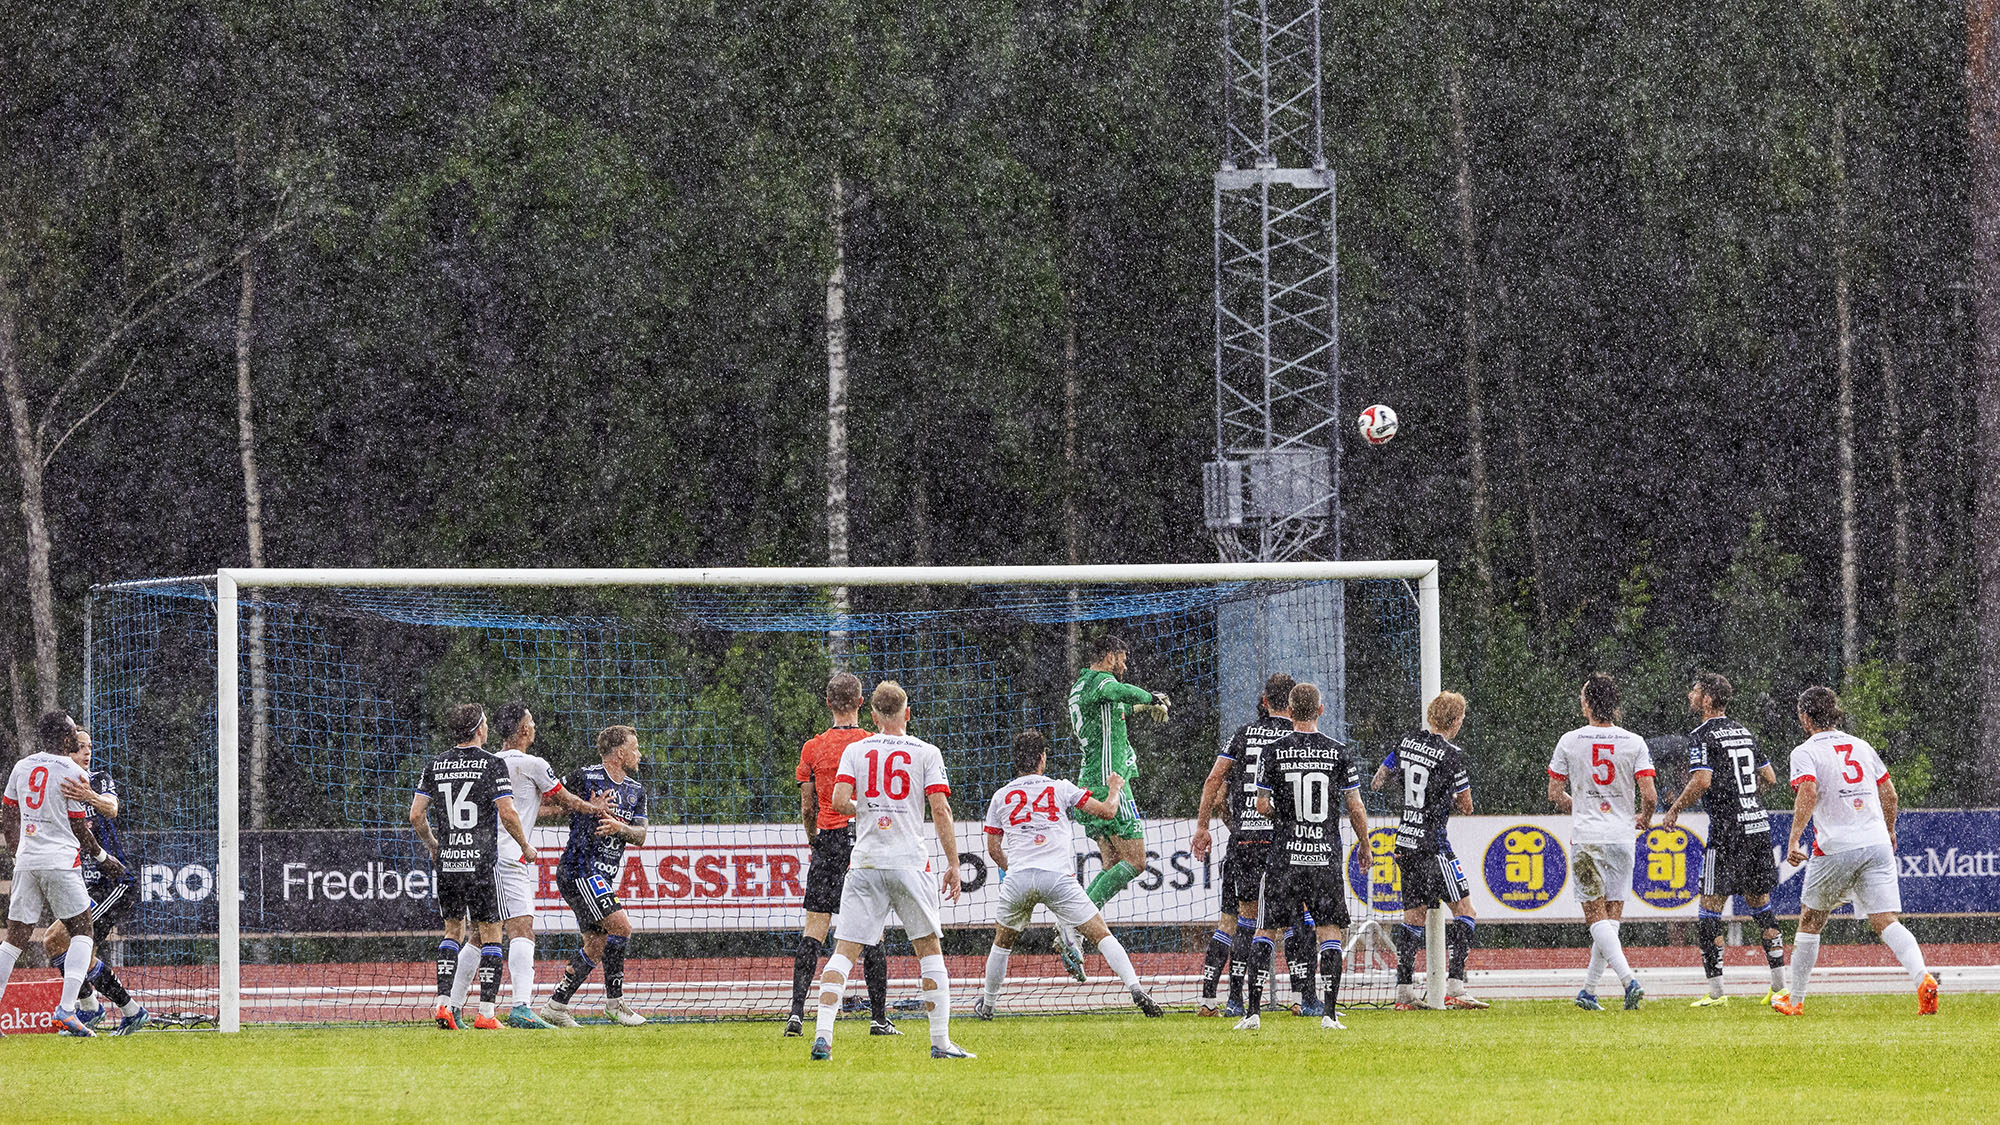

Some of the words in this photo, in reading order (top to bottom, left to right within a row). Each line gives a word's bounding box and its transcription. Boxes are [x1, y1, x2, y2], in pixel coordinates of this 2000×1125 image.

[433, 758, 489, 771] Infrakraft
[1275, 746, 1339, 760] Infrakraft
[1401, 737, 1446, 761] Infrakraft
[1592, 743, 1616, 786] 5
[1833, 743, 1864, 784] 3
[434, 770, 483, 781] BRASSERIET
[864, 749, 912, 801] 16
[1243, 746, 1265, 793] 3
[1280, 761, 1335, 771] BRASSERIET
[1727, 747, 1757, 795] 13
[26, 766, 49, 810] 9
[1284, 771, 1330, 823] 10
[1400, 760, 1430, 809] 18
[438, 781, 478, 830] 16
[1004, 786, 1060, 827] 24
[448, 832, 474, 846] UTAB
[1132, 822, 1142, 833] 32
[1294, 824, 1324, 840] UTAB
[439, 847, 481, 860] HÖJDENS
[1285, 839, 1333, 853] HÖJDENS
[140, 863, 245, 901] RO
[600, 896, 613, 909] 21
